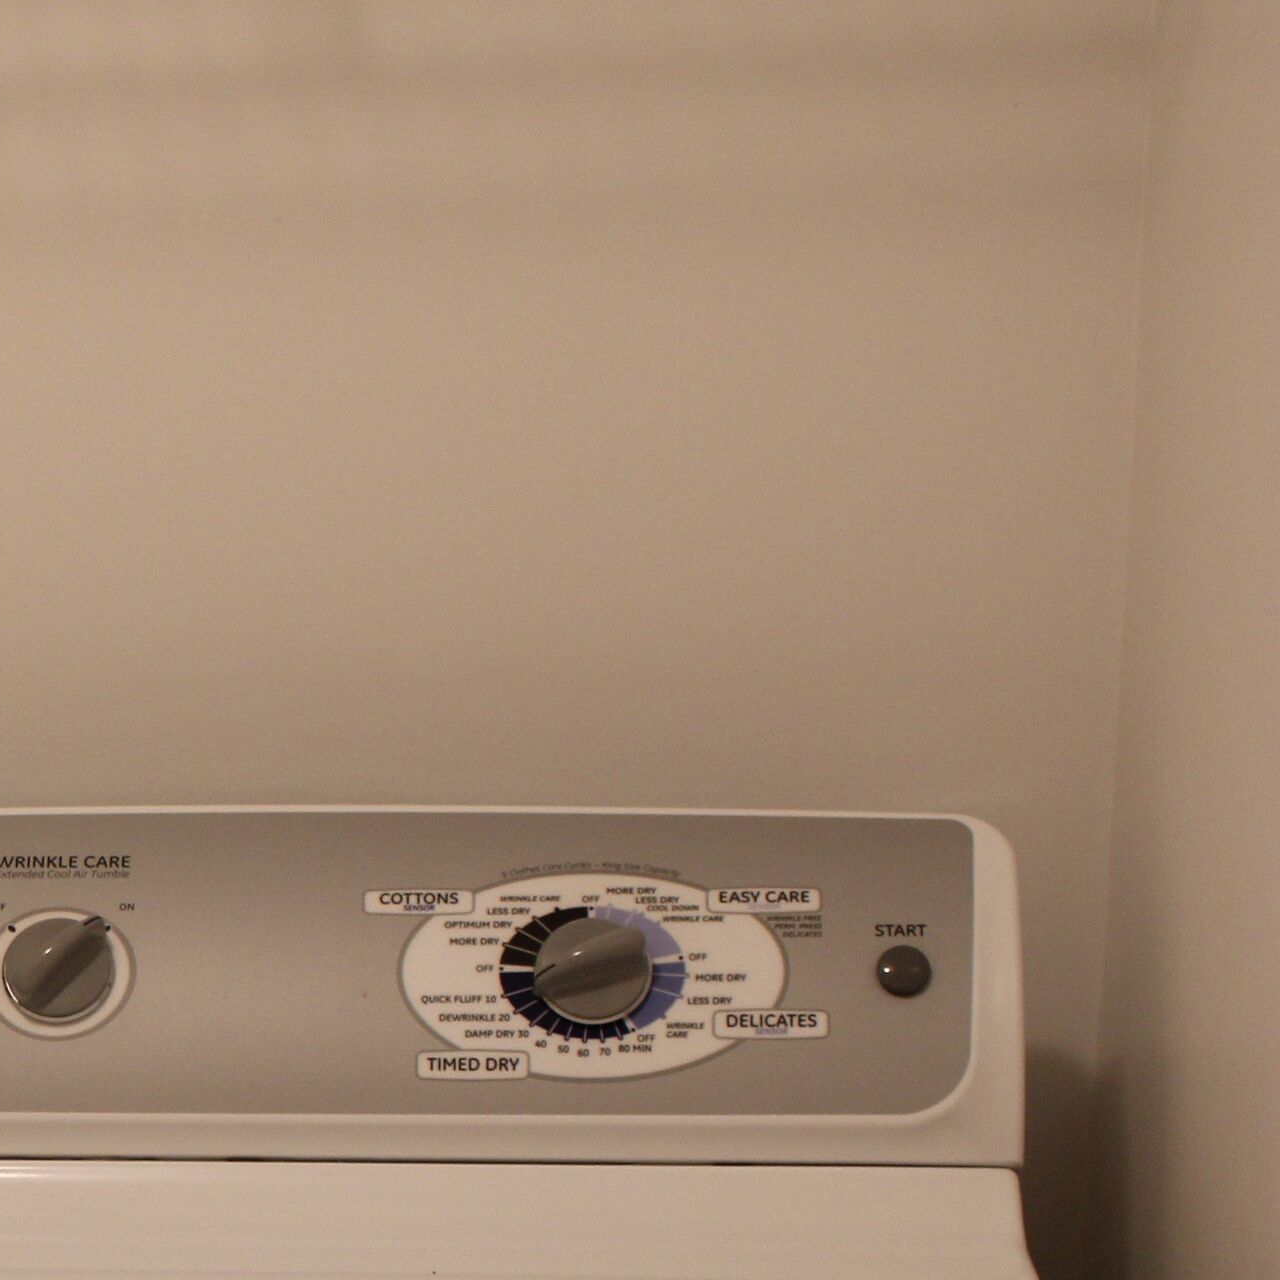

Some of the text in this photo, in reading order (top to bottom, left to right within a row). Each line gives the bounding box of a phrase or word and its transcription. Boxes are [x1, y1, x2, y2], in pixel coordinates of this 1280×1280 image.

[84, 856, 131, 869] CARE
[47, 870, 71, 879] Cool
[73, 870, 88, 879] Air
[91, 870, 131, 879] Tumble
[606, 887, 657, 895] MORE DRY
[379, 892, 459, 905] COTTONS
[500, 895, 561, 903] WRINKLE CARE
[581, 895, 600, 904] OFF
[635, 896, 680, 904] LESS DRY
[718, 891, 811, 904] EASY CARE
[119, 903, 135, 911] ON
[403, 904, 436, 912] SENSOR
[486, 907, 531, 916] LESS DRY
[646, 904, 700, 912] COOL DOWN
[662, 915, 724, 923] WRINKLE CARE
[444, 921, 513, 929] OPTIMUM DRY
[874, 924, 927, 937] START
[449, 938, 500, 946] MORE DRY
[688, 953, 708, 961] OFF
[475, 965, 495, 973] OFF
[695, 973, 747, 982] MORE DRY
[421, 995, 497, 1005] QUICK FLUFF 10
[687, 997, 733, 1005] LESS DRY
[438, 1013, 511, 1023] DEWRINKLE 20
[726, 1014, 818, 1028] DELICATES
[666, 1022, 705, 1030] WRINKLE
[464, 1030, 530, 1039] DAMP DRY 30
[637, 1033, 657, 1043] OFF
[666, 1030, 688, 1039] CARE
[534, 1039, 547, 1049] 40
[618, 1044, 653, 1053] 80 MIN
[557, 1044, 570, 1054] 50
[577, 1048, 590, 1058] 60
[599, 1047, 612, 1057] 70
[427, 1057, 521, 1072] TIMED DRY
